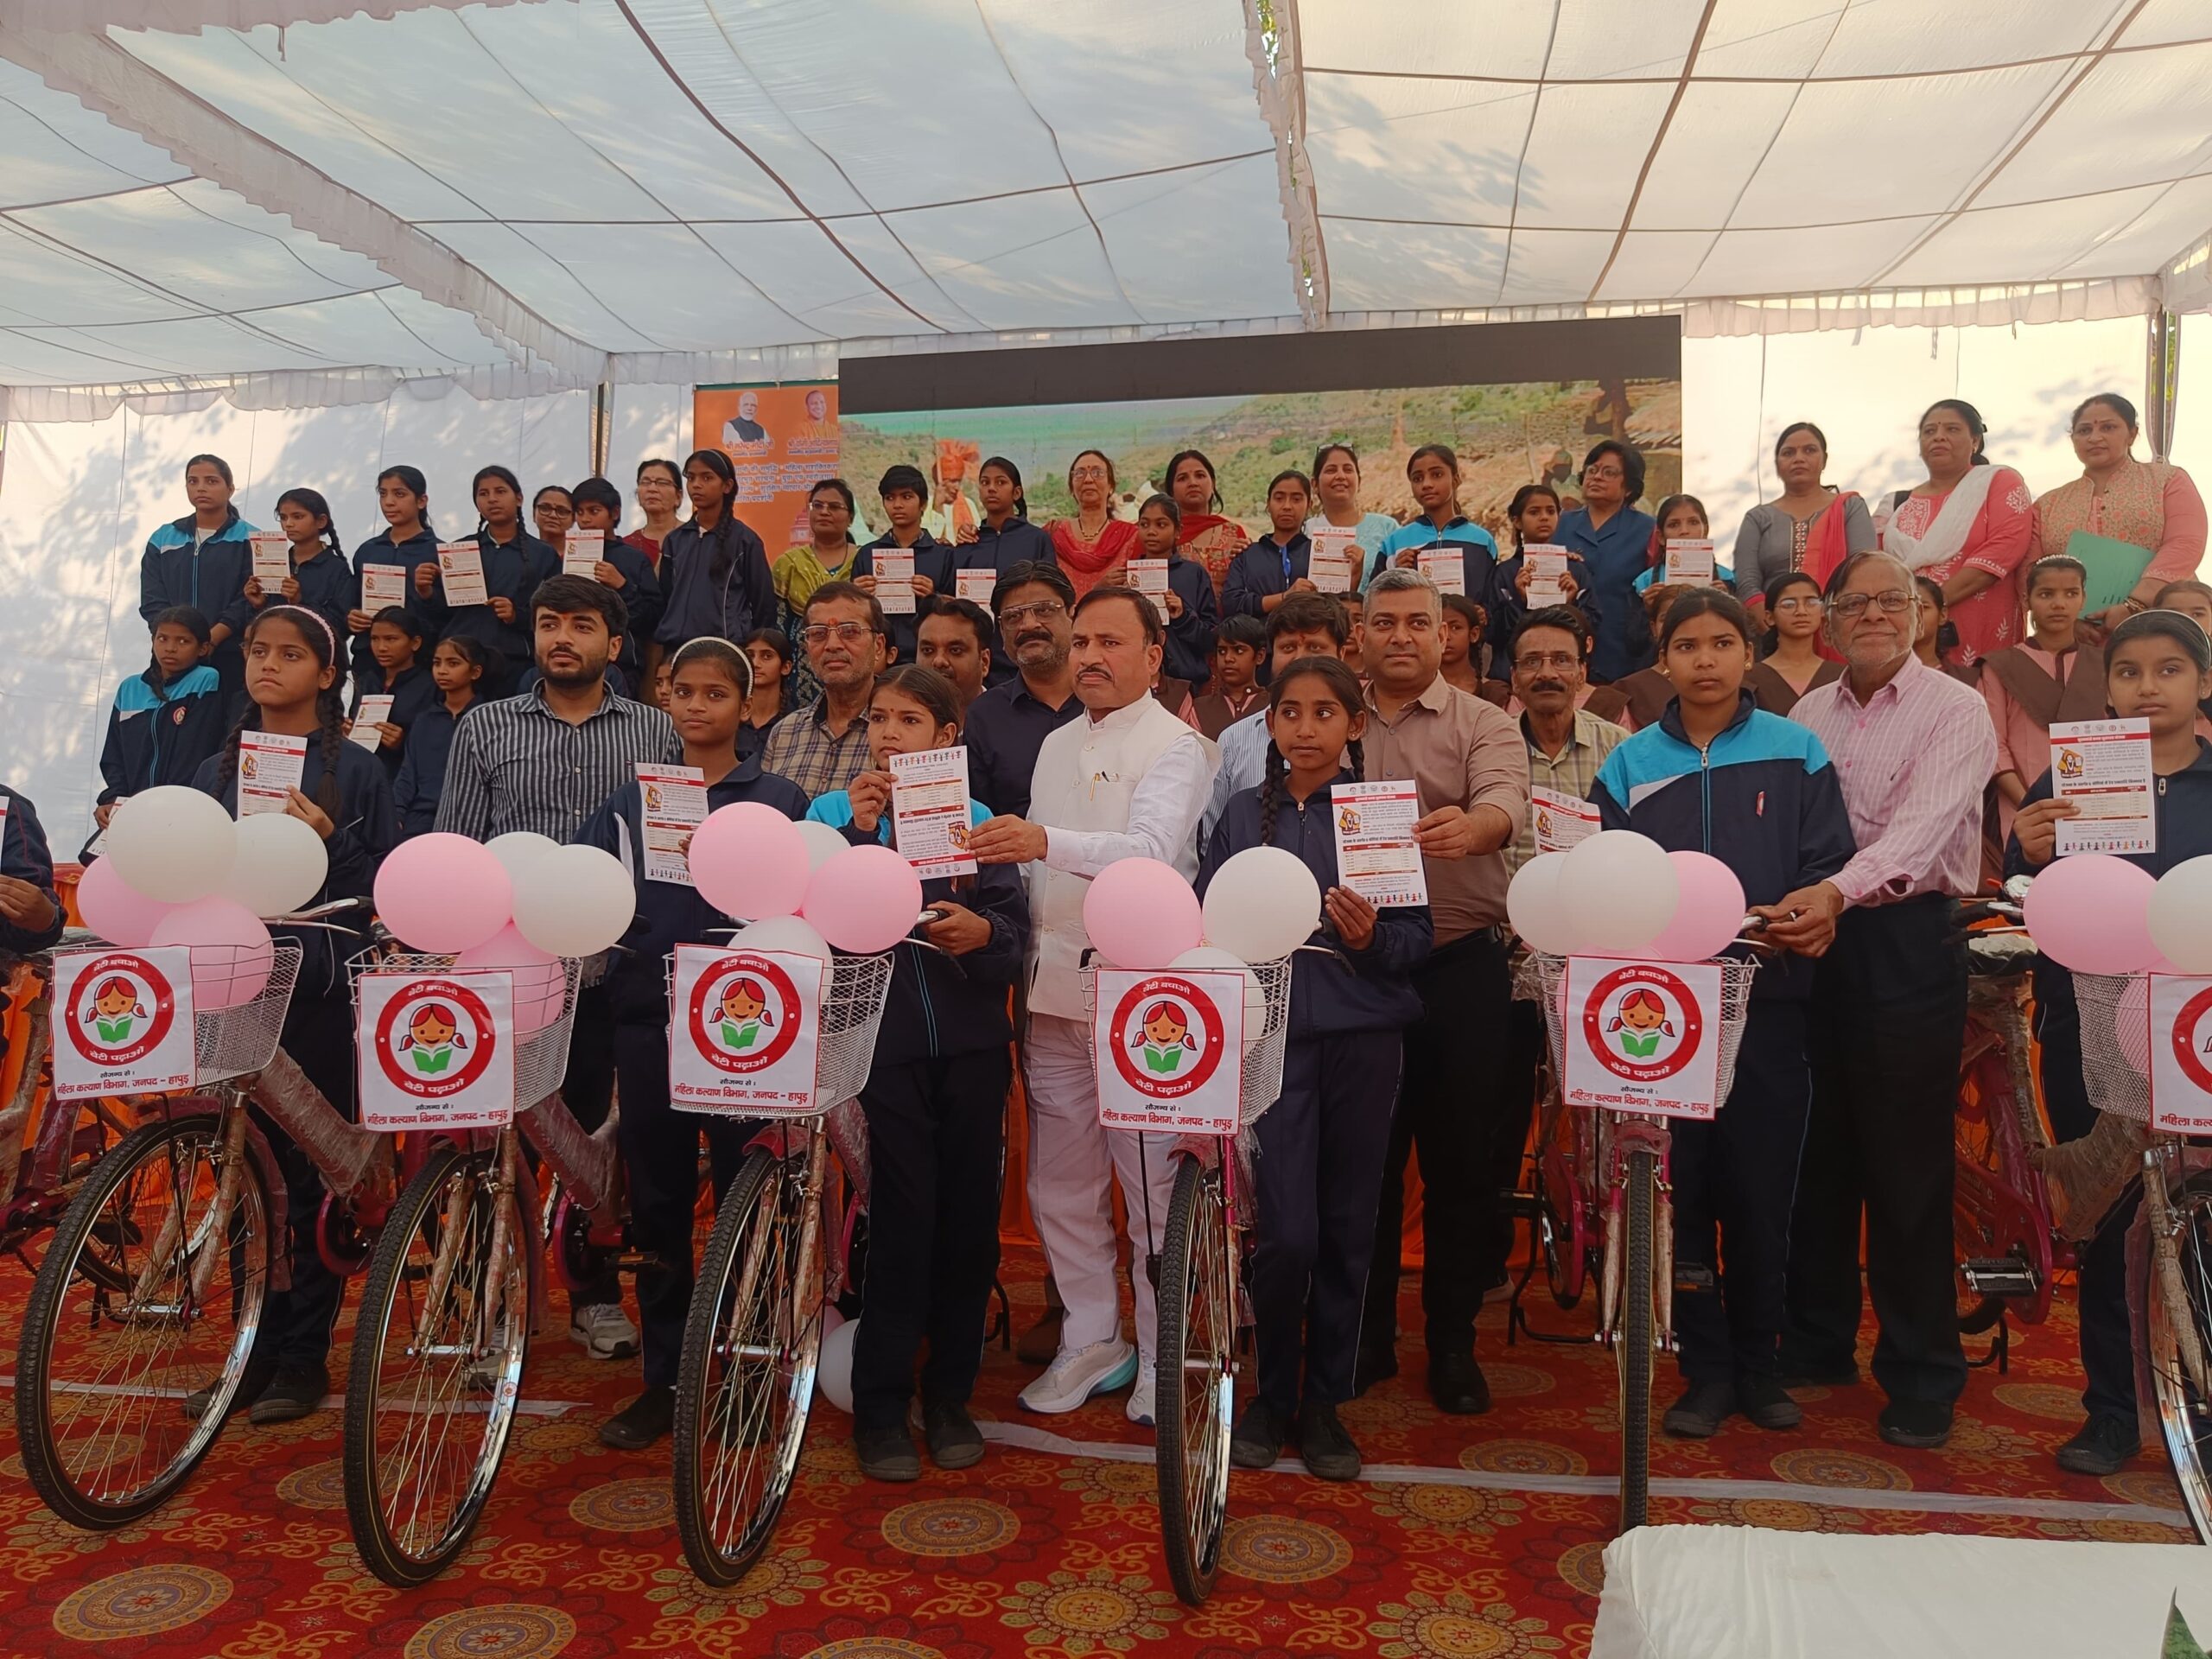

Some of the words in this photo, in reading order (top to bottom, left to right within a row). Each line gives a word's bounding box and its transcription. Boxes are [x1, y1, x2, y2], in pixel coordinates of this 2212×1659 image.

[94, 959, 109, 972] बेटी
[111, 959, 139, 968] बचाओ
[721, 959, 737, 969] बेटी
[740, 959, 769, 972] बचाओ
[409, 984, 423, 996] बेटी
[427, 985, 458, 995] बचाओ
[1143, 982, 1158, 993] बेटी
[1161, 982, 1190, 995] बचाओ
[90, 1051, 107, 1061] बेटी
[711, 1053, 729, 1066] बेटी
[57, 1084, 74, 1094] महिला
[77, 1083, 101, 1092] कल्याण
[132, 1078, 157, 1087] जनपद
[404, 1081, 424, 1092] बेटी
[675, 1083, 695, 1094] महिला
[696, 1088, 721, 1096] कल्याण
[753, 1090, 778, 1099] जनपद
[1135, 1078, 1154, 1092] बेटी
[1569, 1089, 1592, 1101] महिला
[1594, 1094, 1622, 1103] कल्याण
[1655, 1099, 1681, 1109] जनपद
[367, 1114, 387, 1124] महिला
[390, 1115, 417, 1123] कल्याण
[451, 1112, 478, 1121] जनपद
[1103, 1109, 1119, 1121] महिला
[1121, 1113, 1147, 1122] कल्याण
[1178, 1116, 1203, 1126] जनपद
[2160, 1114, 2190, 1126] महिला
